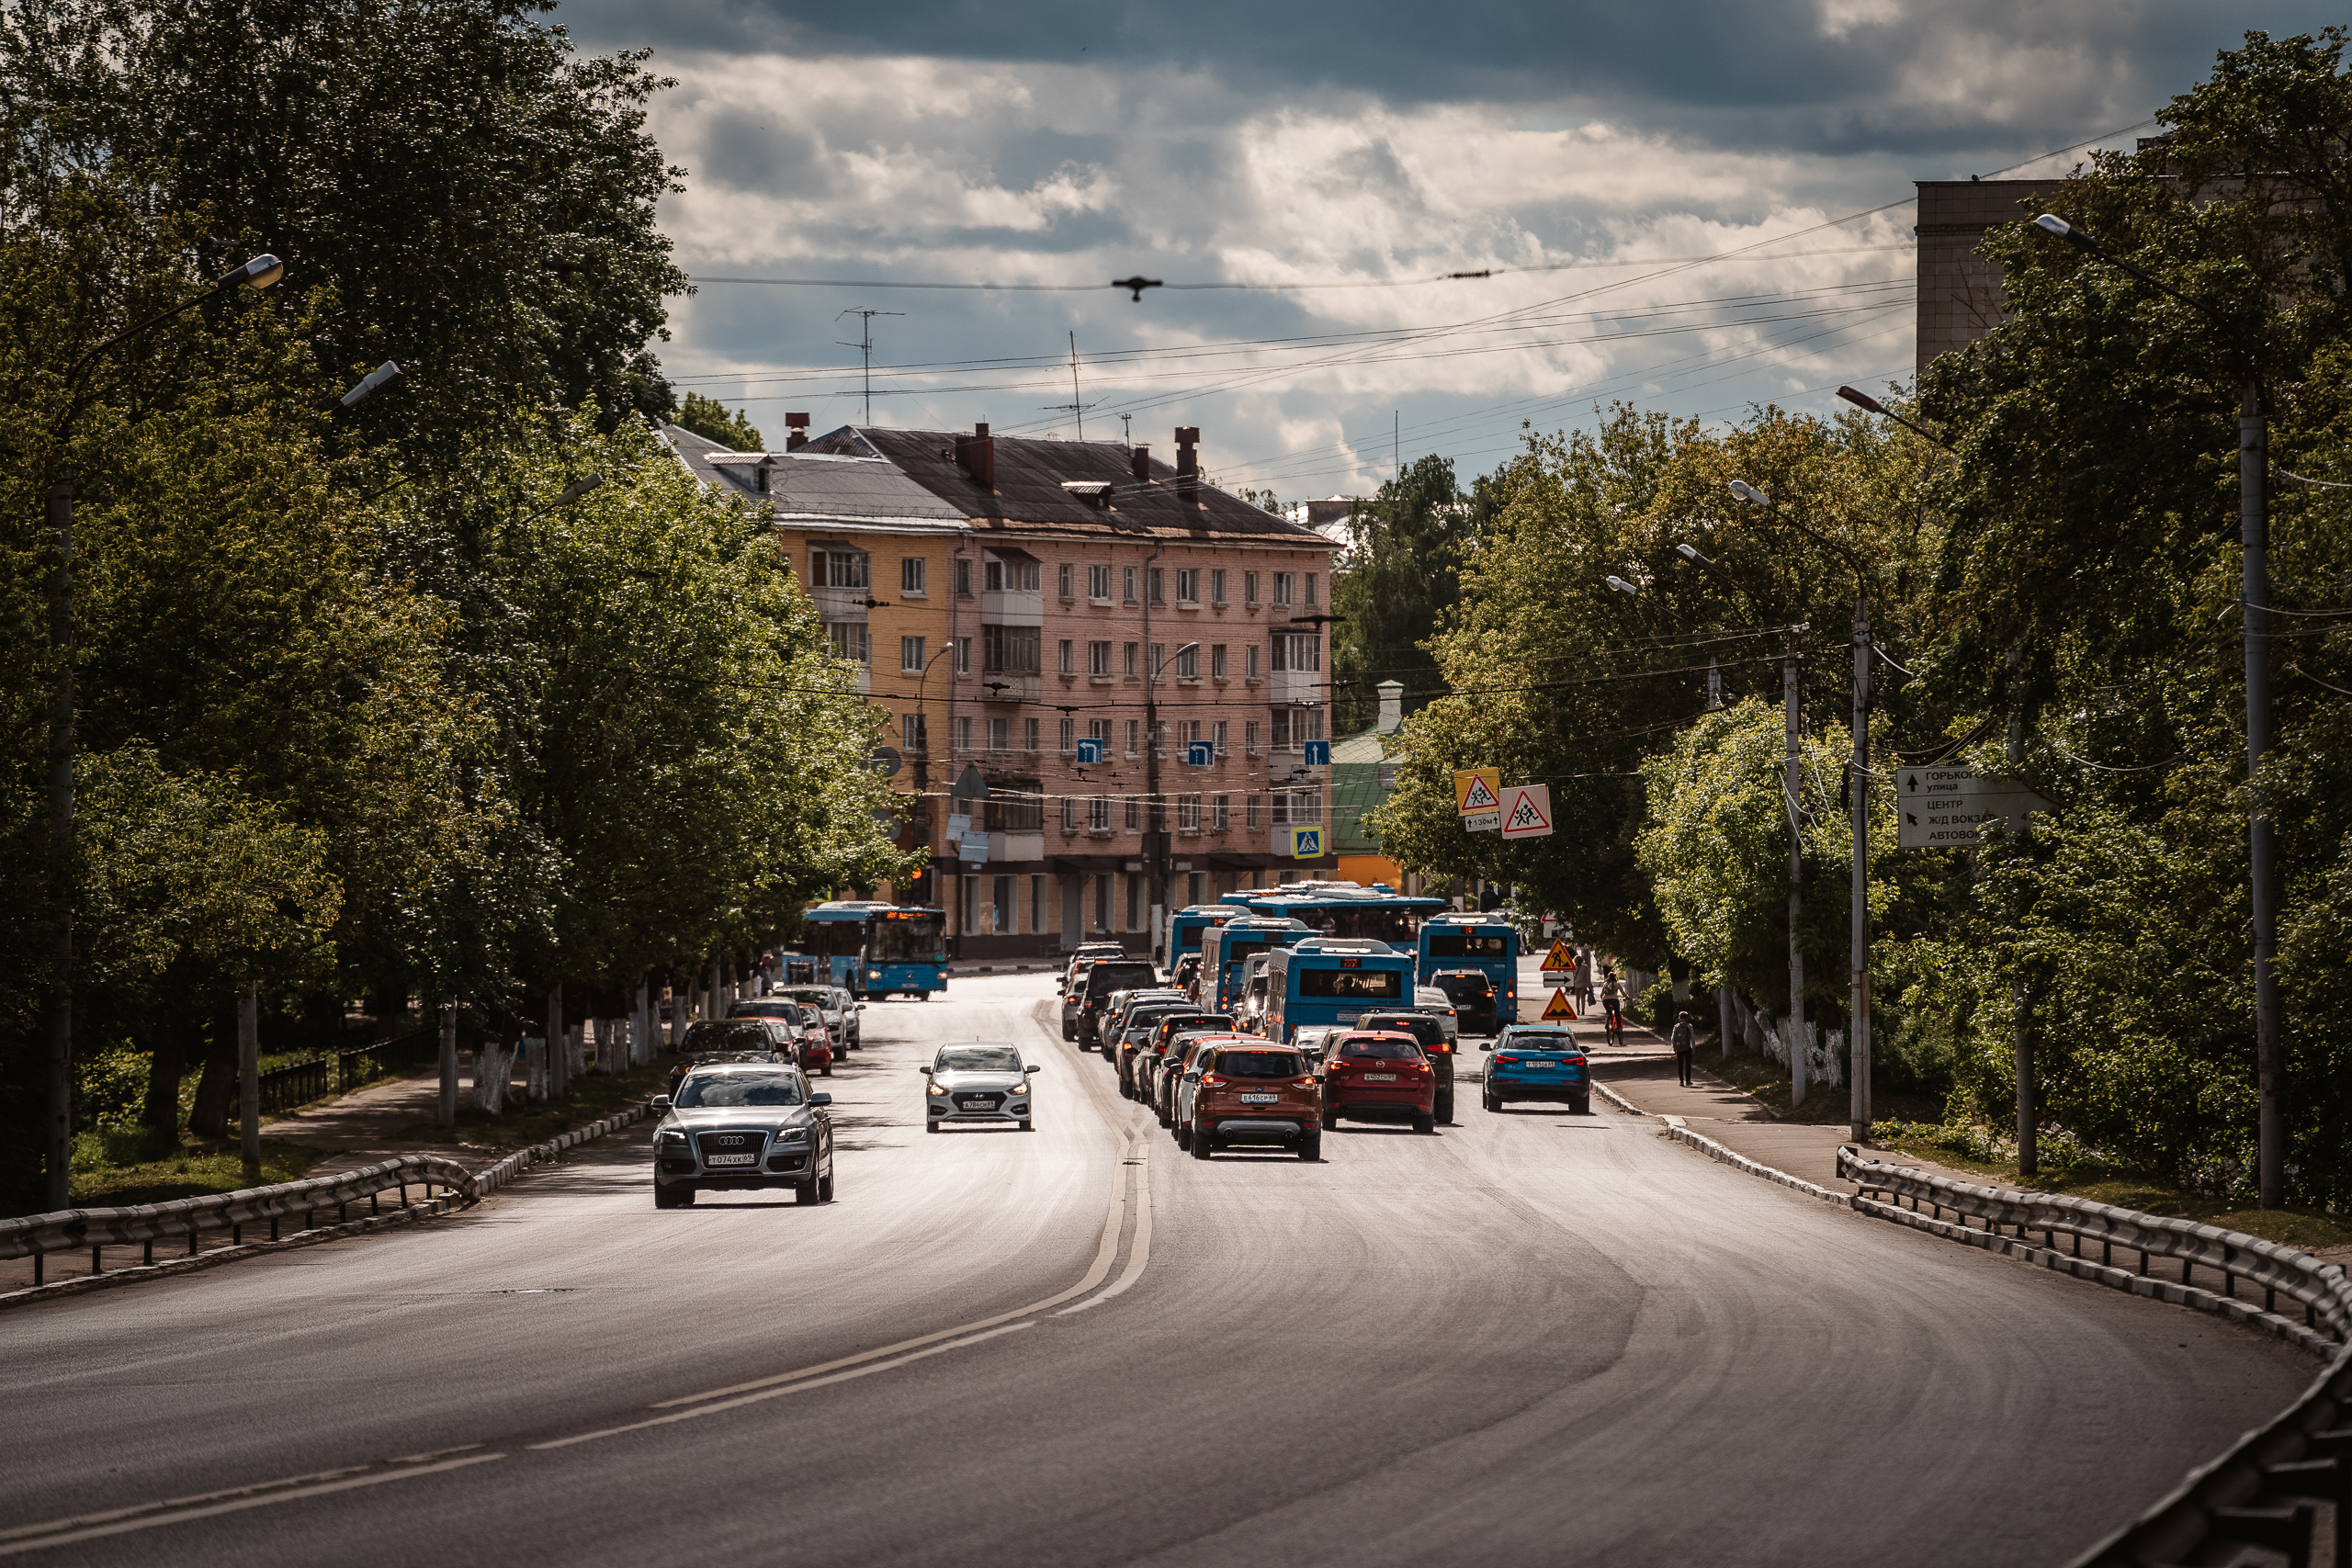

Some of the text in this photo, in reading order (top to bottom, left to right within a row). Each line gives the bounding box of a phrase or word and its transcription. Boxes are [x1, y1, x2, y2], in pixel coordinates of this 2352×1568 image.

[1927, 784, 1959, 793] улица
[1928, 800, 1963, 810] ЦЕНТР
[1928, 816, 1949, 826] Ж/Д
[1929, 830, 1981, 840] АВТОВОК
